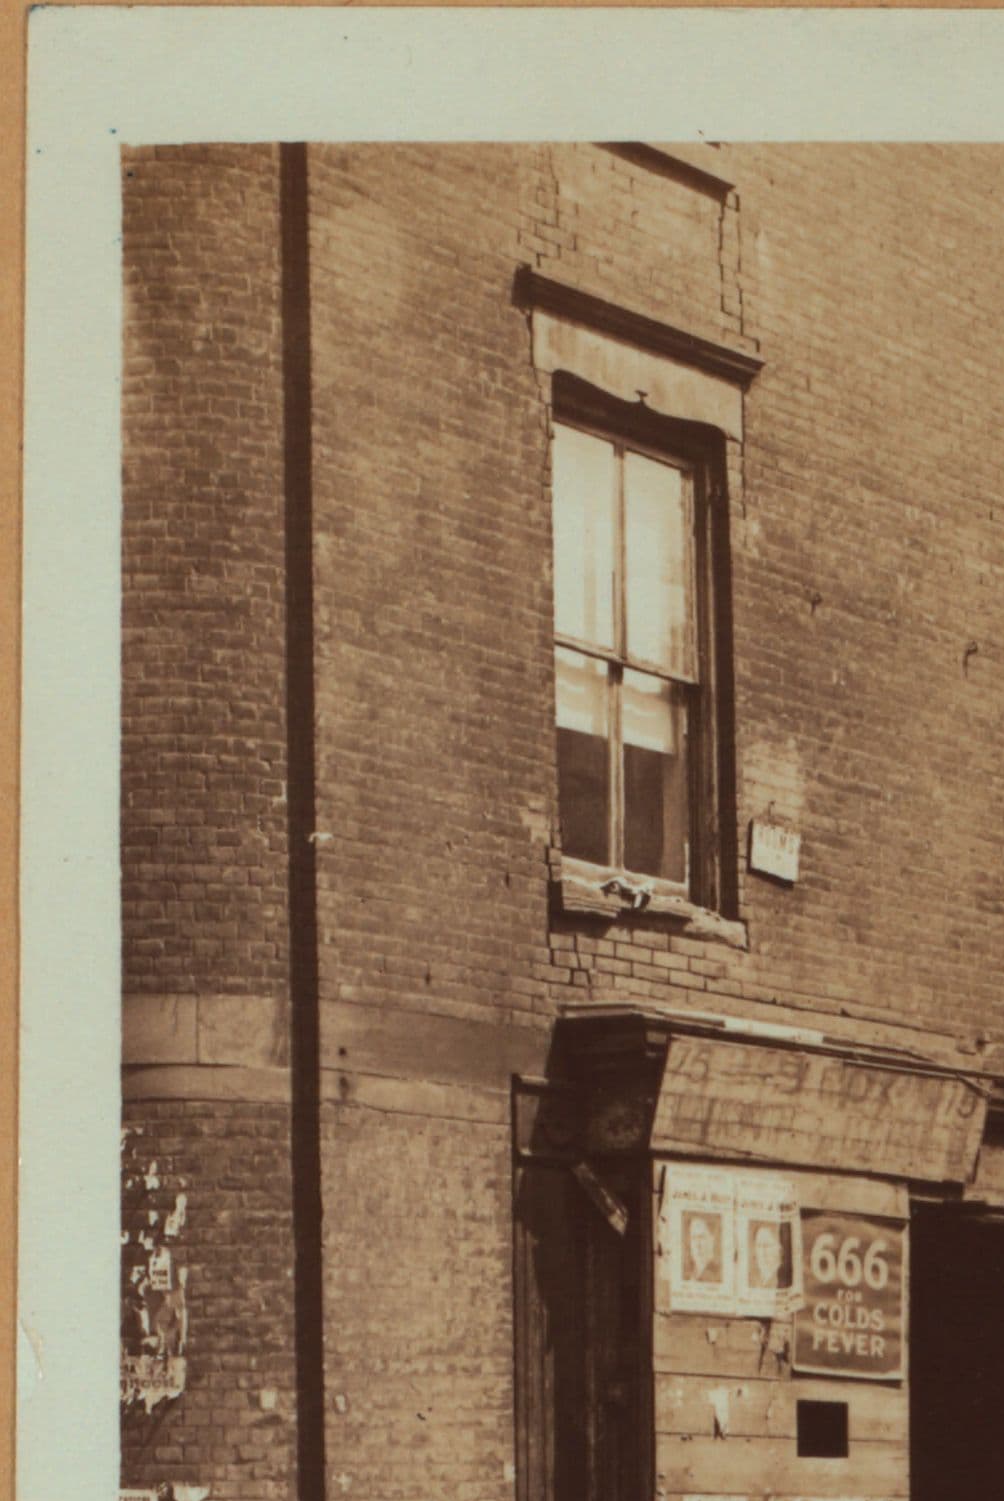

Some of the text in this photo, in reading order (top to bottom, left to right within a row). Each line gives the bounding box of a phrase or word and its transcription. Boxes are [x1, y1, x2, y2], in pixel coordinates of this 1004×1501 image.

[810, 1232, 889, 1291] 666
[813, 1302, 885, 1331] COLDS
[812, 1328, 885, 1358] FEVER
